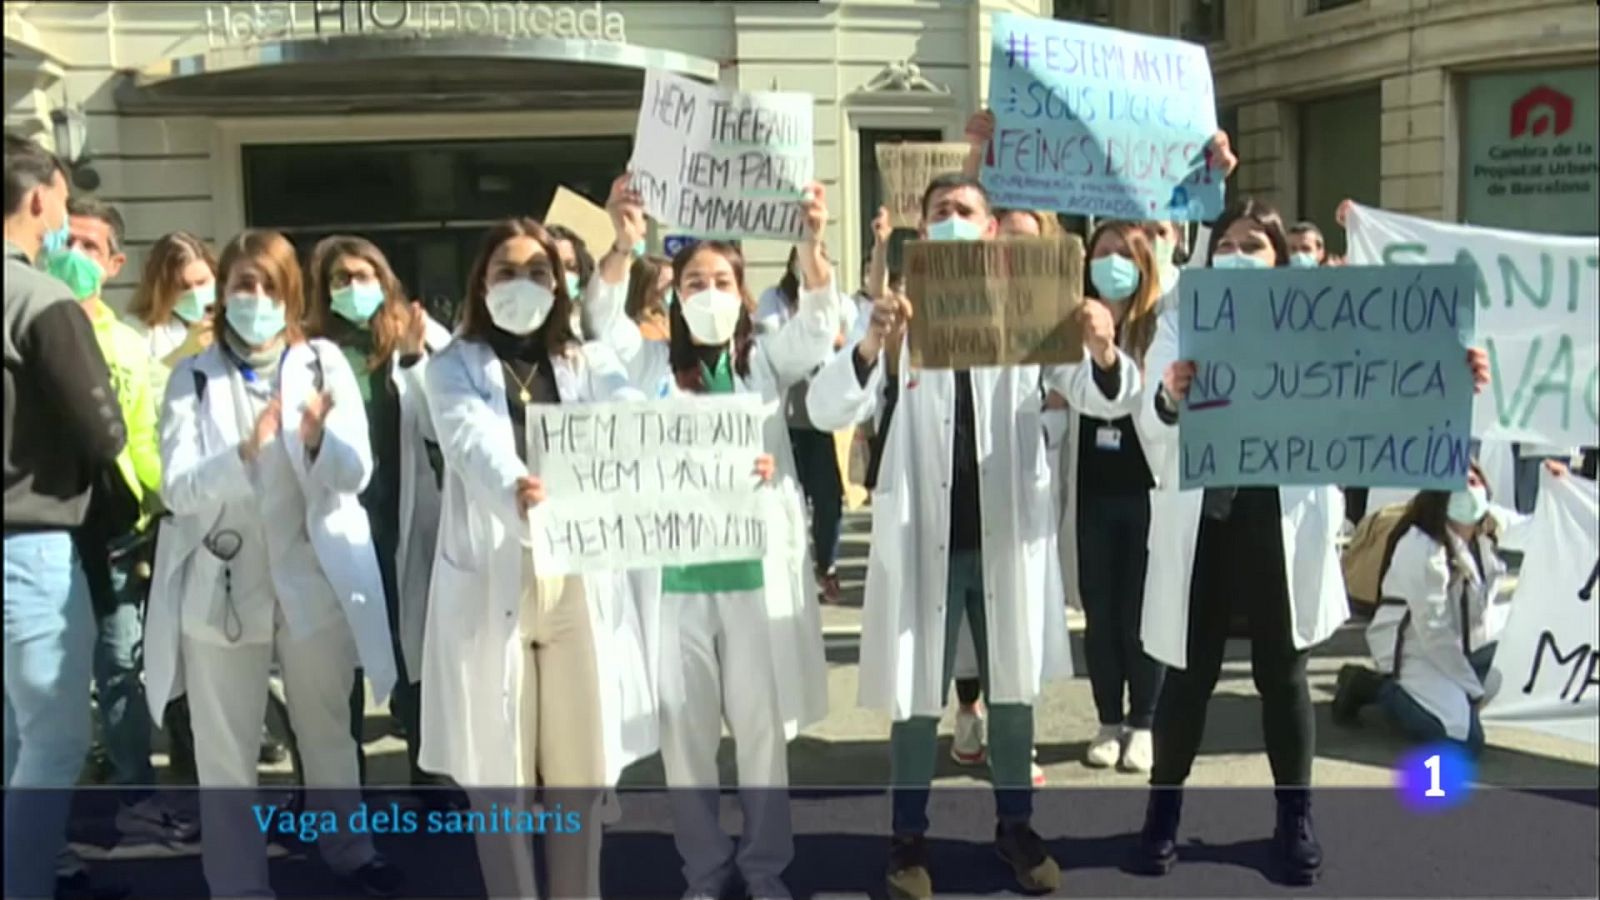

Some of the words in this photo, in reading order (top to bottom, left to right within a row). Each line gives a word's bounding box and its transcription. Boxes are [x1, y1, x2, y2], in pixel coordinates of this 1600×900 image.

[423, 3, 627, 40] montcada
[652, 80, 696, 135] HEM
[1020, 80, 1096, 122] SOUS
[679, 145, 730, 189] HEM
[1474, 163, 1543, 180] Propietat
[1488, 144, 1548, 160] Cambra
[1553, 143, 1572, 157] de
[1578, 141, 1592, 155] la
[1487, 182, 1506, 196] de
[1511, 179, 1590, 195] Barcelona
[1192, 286, 1235, 332] LA
[1269, 271, 1458, 332] VOCACIÓN
[1187, 360, 1236, 400] NO
[1253, 349, 1446, 400] JUSTIFICA
[540, 412, 616, 453] HEM
[1184, 440, 1216, 480] LA
[1239, 420, 1469, 478] EXPLOTACIÓN
[572, 458, 640, 494] HEM
[545, 513, 625, 556] HEM
